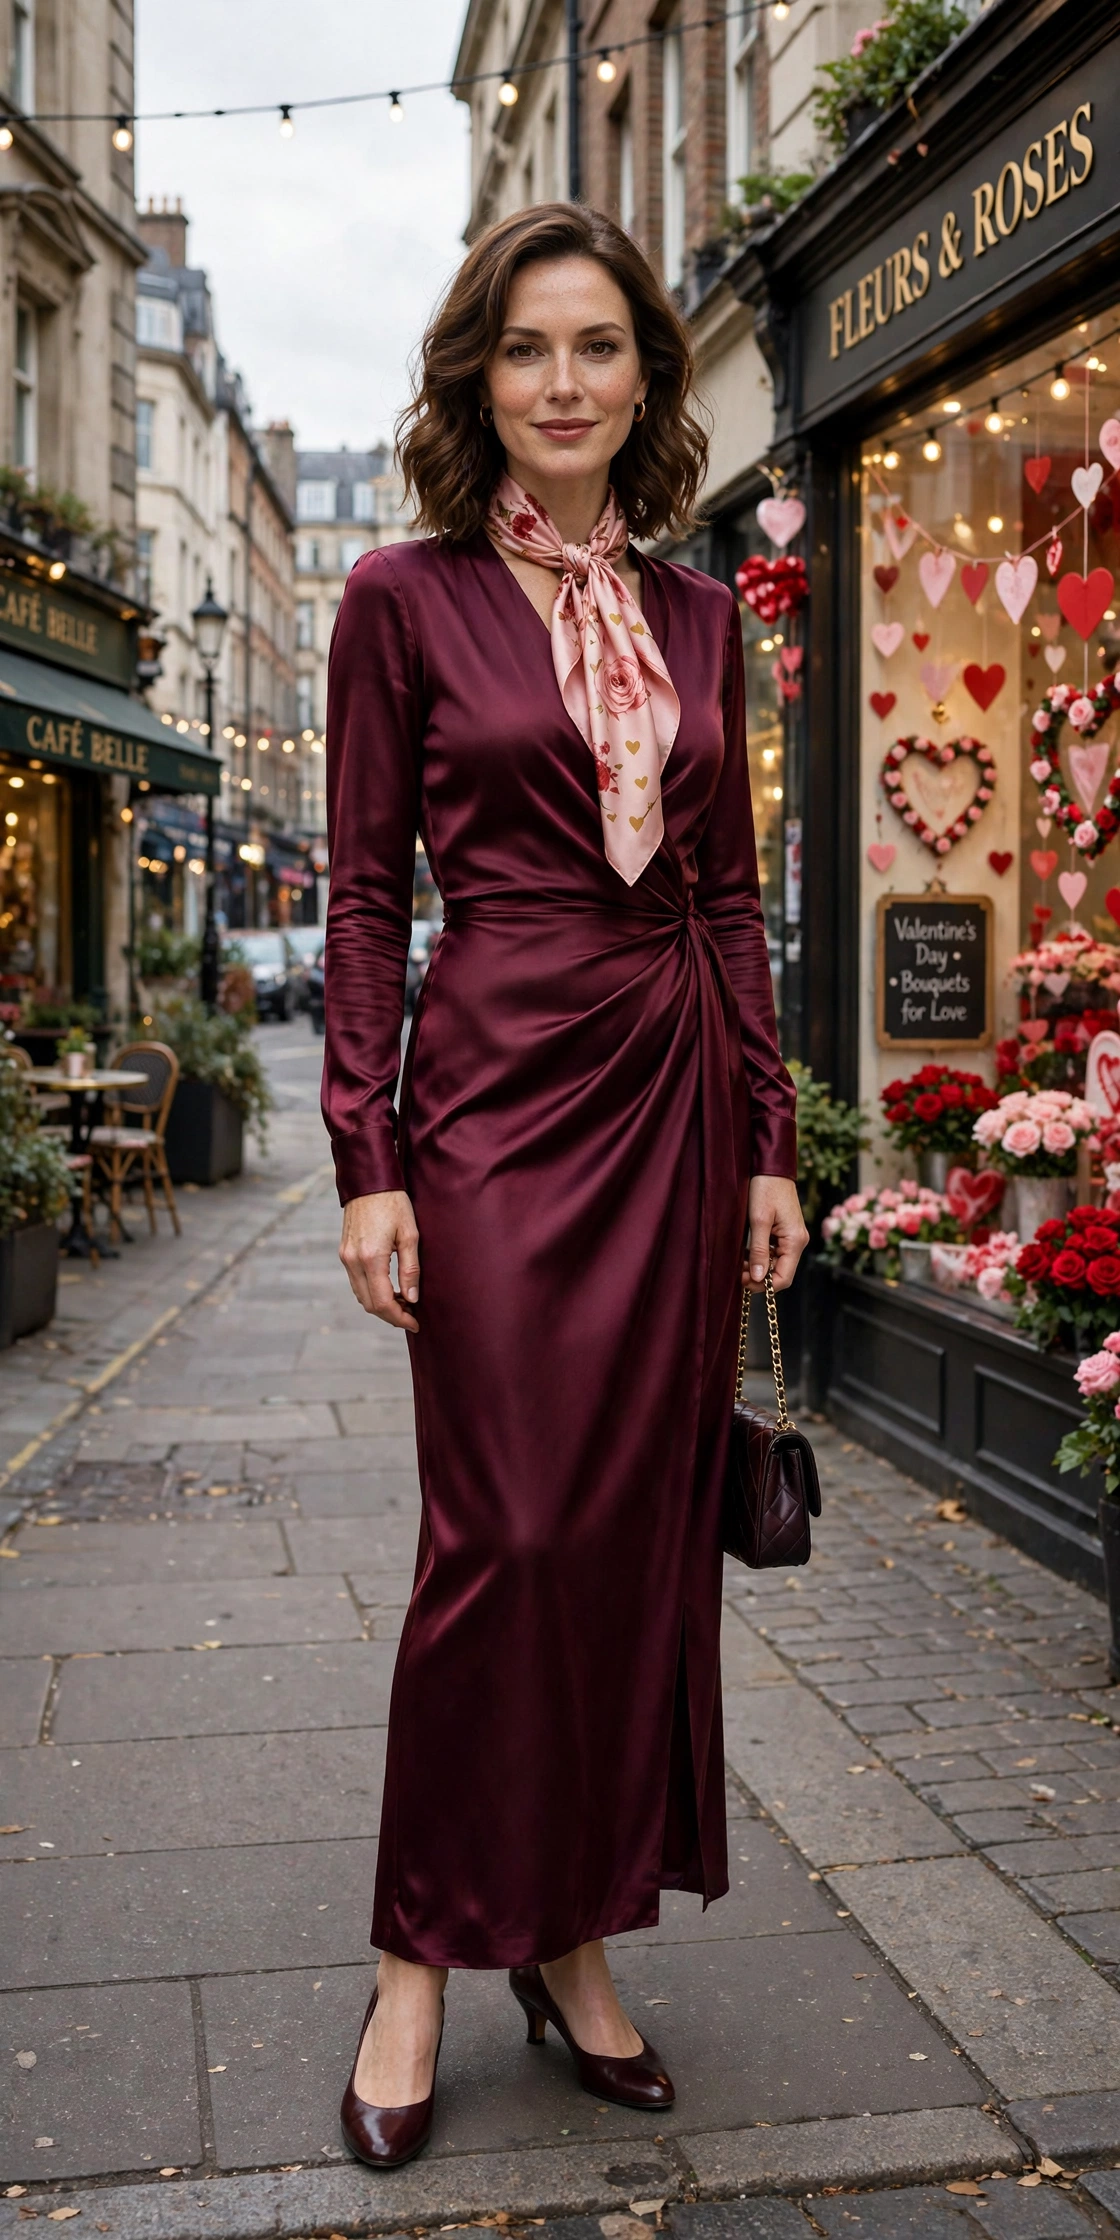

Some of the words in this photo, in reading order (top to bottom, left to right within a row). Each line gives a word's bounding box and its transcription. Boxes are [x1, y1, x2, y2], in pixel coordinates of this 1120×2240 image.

[829, 231, 931, 360] FLEURS
[938, 211, 964, 278] &
[971, 102, 1093, 257] ROSES
[46, 606, 98, 656] BELLE
[26, 715, 84, 760] CAFÉ
[90, 731, 149, 774] BELLE
[894, 916, 977, 941] Valentine's
[915, 942, 948, 974] Day
[900, 969, 970, 998] Bouquets
[900, 998, 926, 1025] for
[930, 1000, 967, 1021] Love
